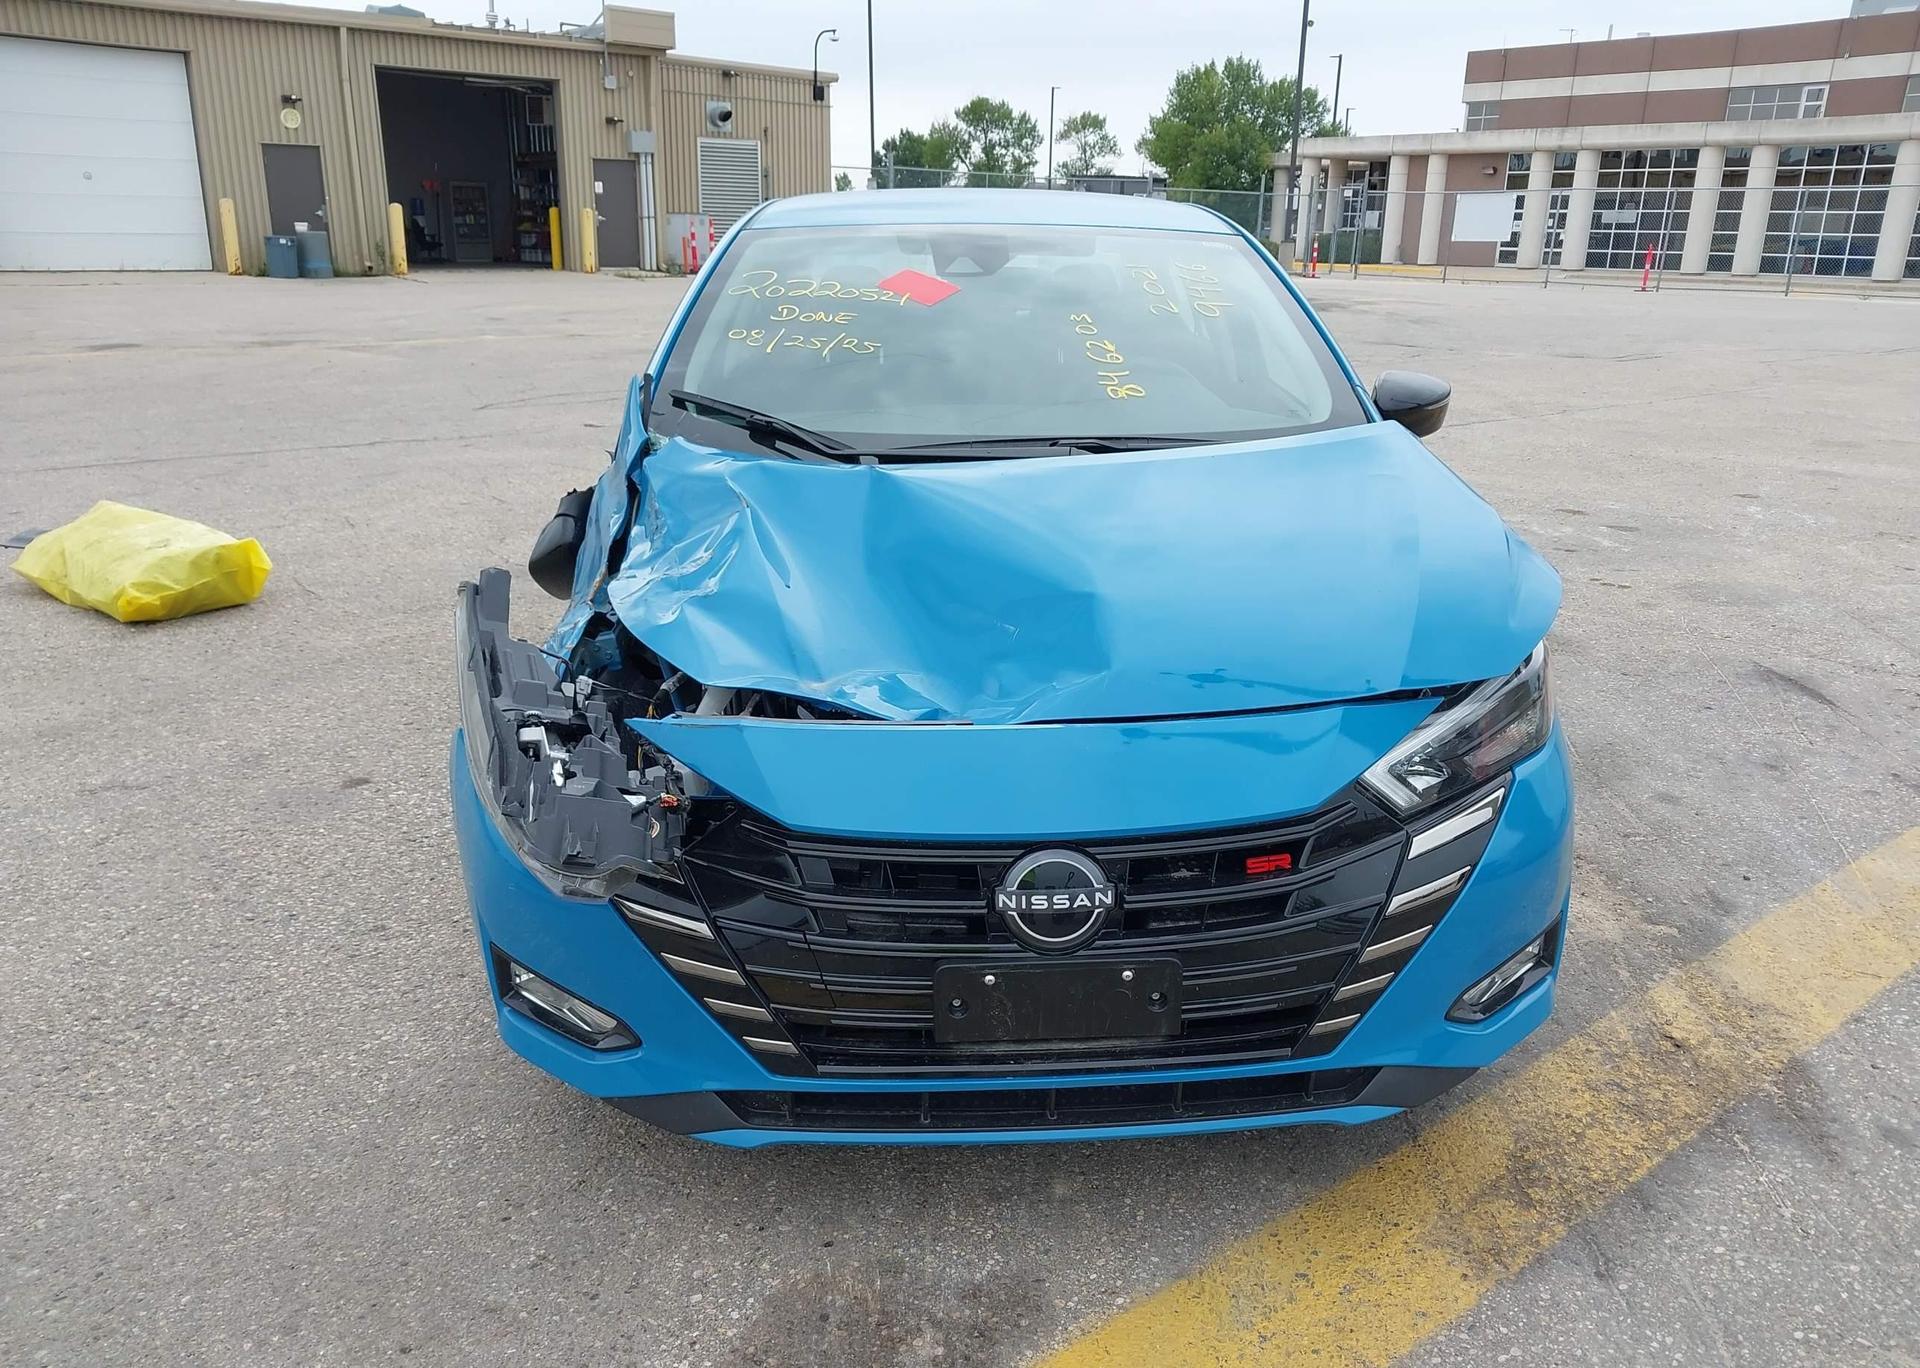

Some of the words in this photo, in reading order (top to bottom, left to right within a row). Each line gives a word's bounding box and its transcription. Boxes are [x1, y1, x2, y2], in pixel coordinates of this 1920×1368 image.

[728, 270, 912, 306] 20220521
[1125, 264, 1180, 316] 2021
[728, 328, 883, 358] 08/25/25
[1245, 853, 1293, 875] SR
[998, 889, 1113, 911] NISSAN
